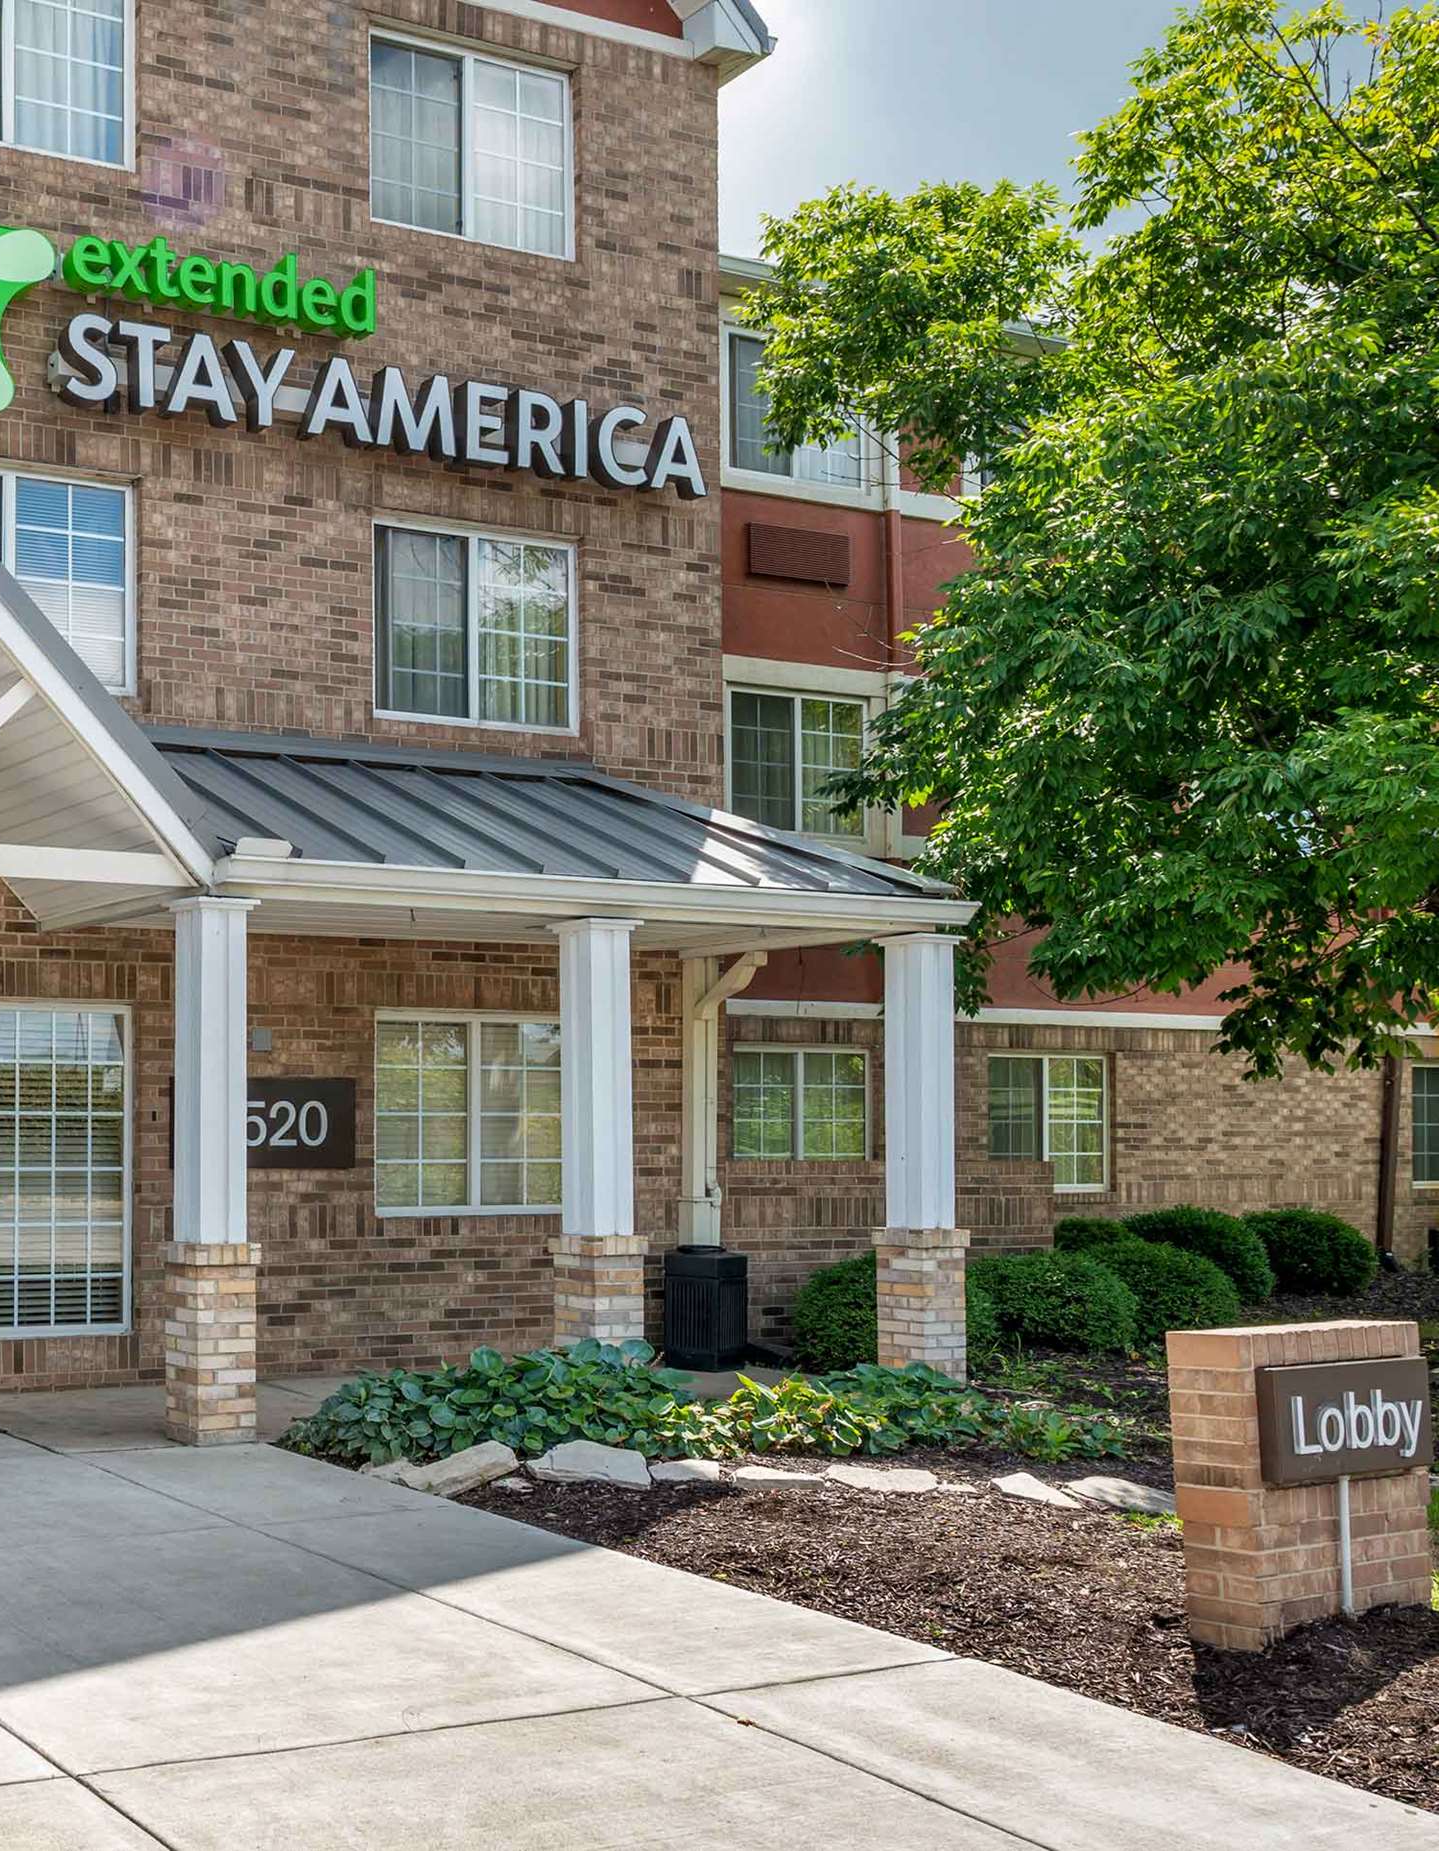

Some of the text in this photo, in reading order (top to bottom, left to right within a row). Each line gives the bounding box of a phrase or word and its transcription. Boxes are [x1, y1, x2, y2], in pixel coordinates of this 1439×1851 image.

[63, 235, 377, 341] extended
[59, 312, 709, 500] STAY AMERICA
[1291, 1389, 1423, 1458] Lobby
